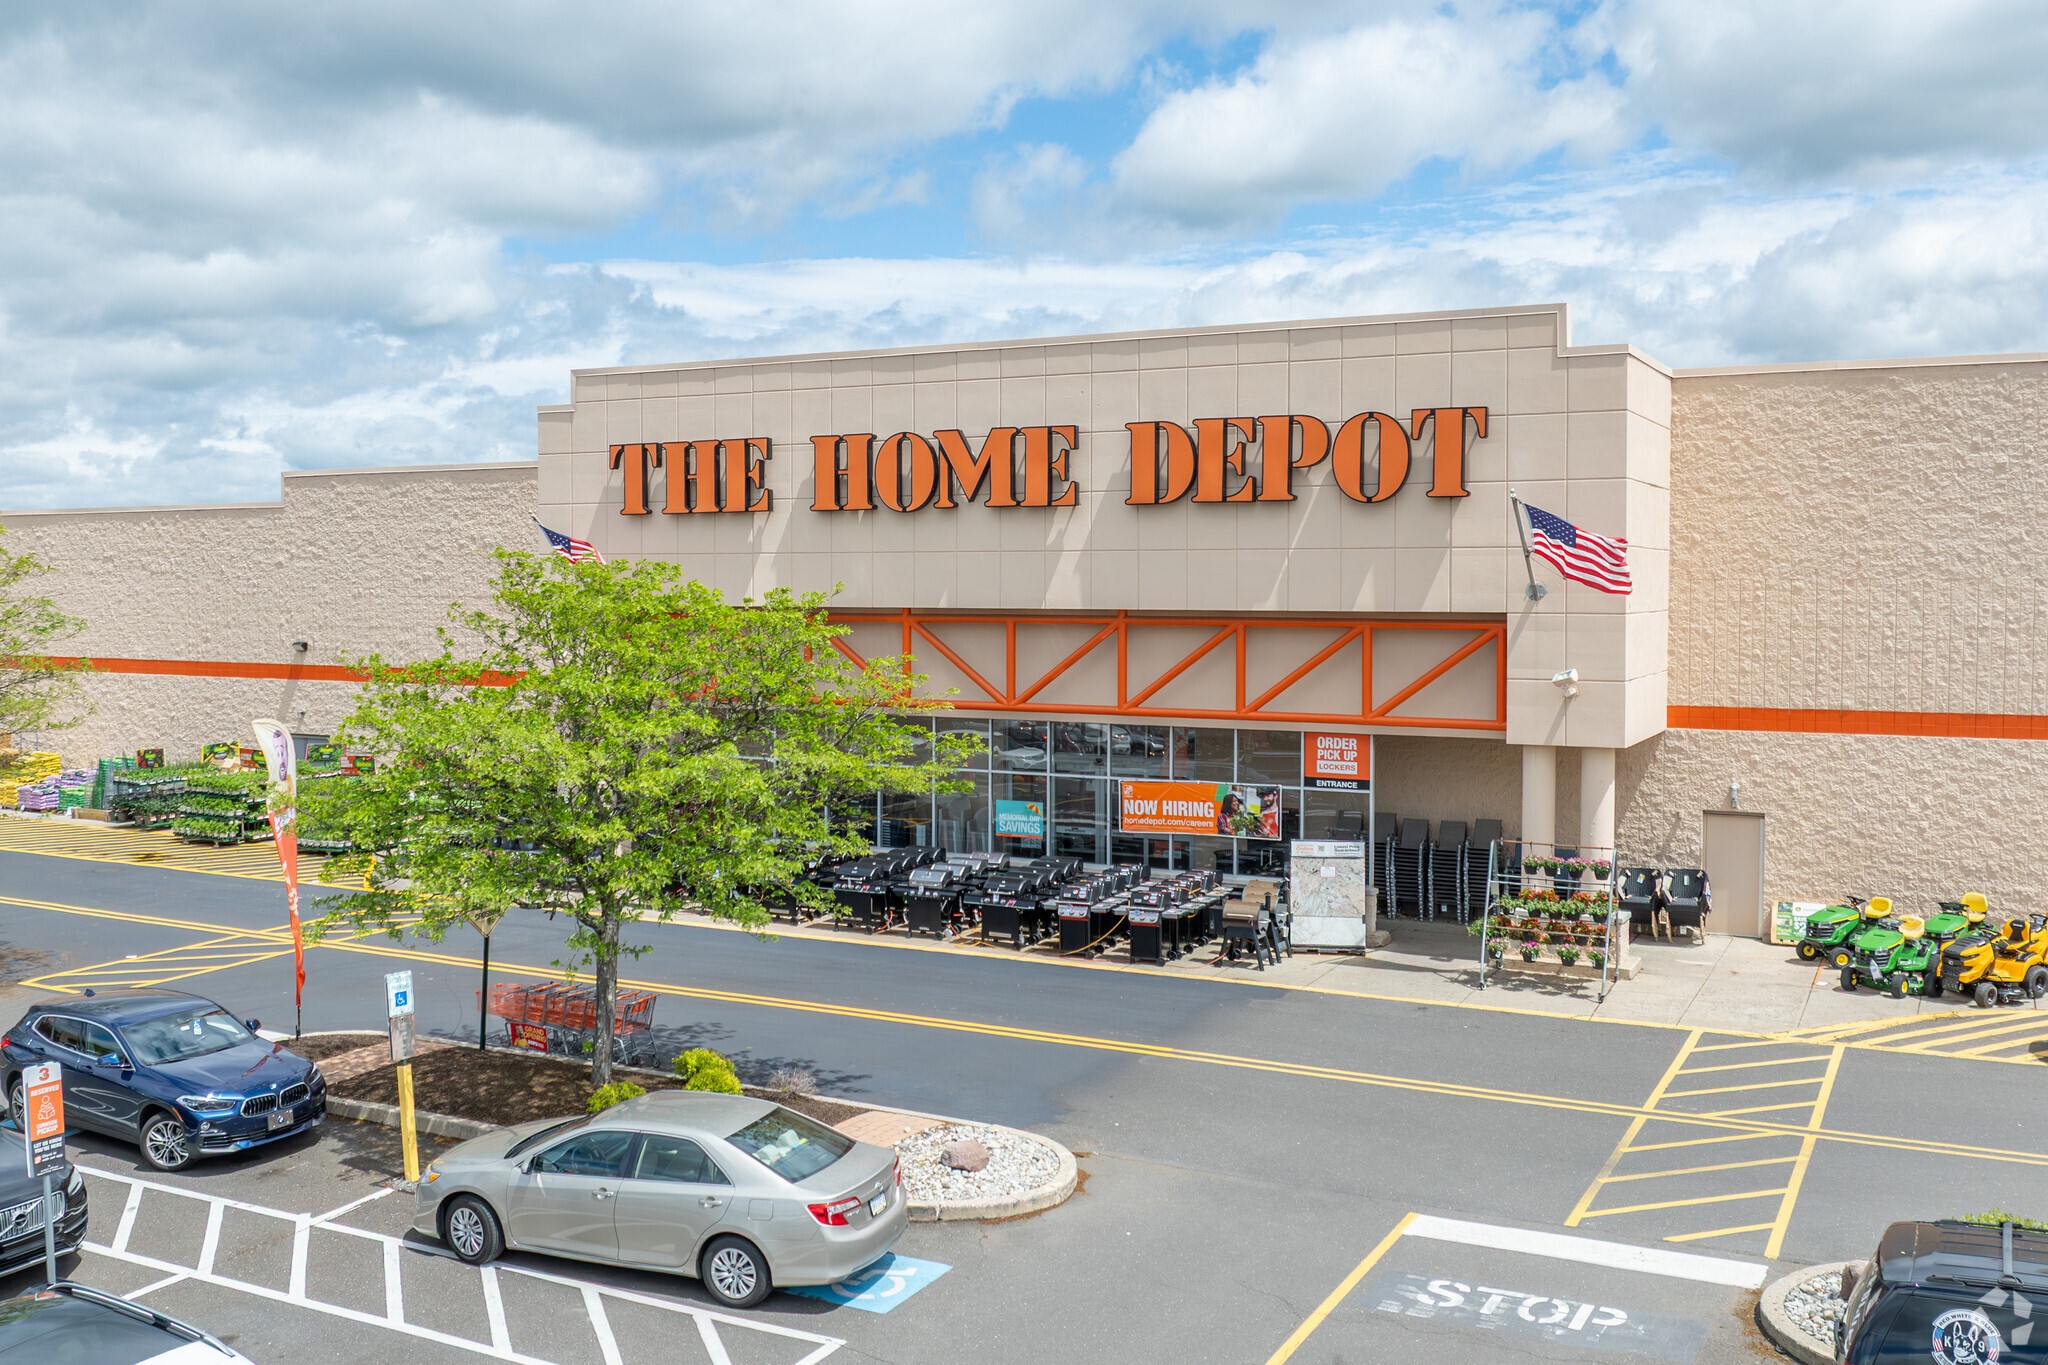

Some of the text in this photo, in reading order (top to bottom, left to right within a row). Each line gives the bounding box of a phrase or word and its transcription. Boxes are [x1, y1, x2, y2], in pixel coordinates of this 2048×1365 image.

[609, 406, 1489, 515] THE HOME DEPOT
[1317, 736, 1357, 750] ORDER
[1317, 749, 1357, 761] PICK UP
[1319, 763, 1356, 771] LOCKERS
[1316, 780, 1358, 788] ENTRANCE
[1123, 799, 1215, 817] NOW HIRING
[999, 813, 1028, 822] MEMORIAL
[1124, 817, 1214, 827] homedepot.com/careers
[999, 821, 1040, 834] SAVINGS
[524, 1025, 545, 1036] GRAND
[523, 1032, 547, 1043] OPENING
[39, 1067, 50, 1081] 3
[1416, 1279, 1628, 1331] STOP
[1944, 1336, 1985, 1353] K 9
